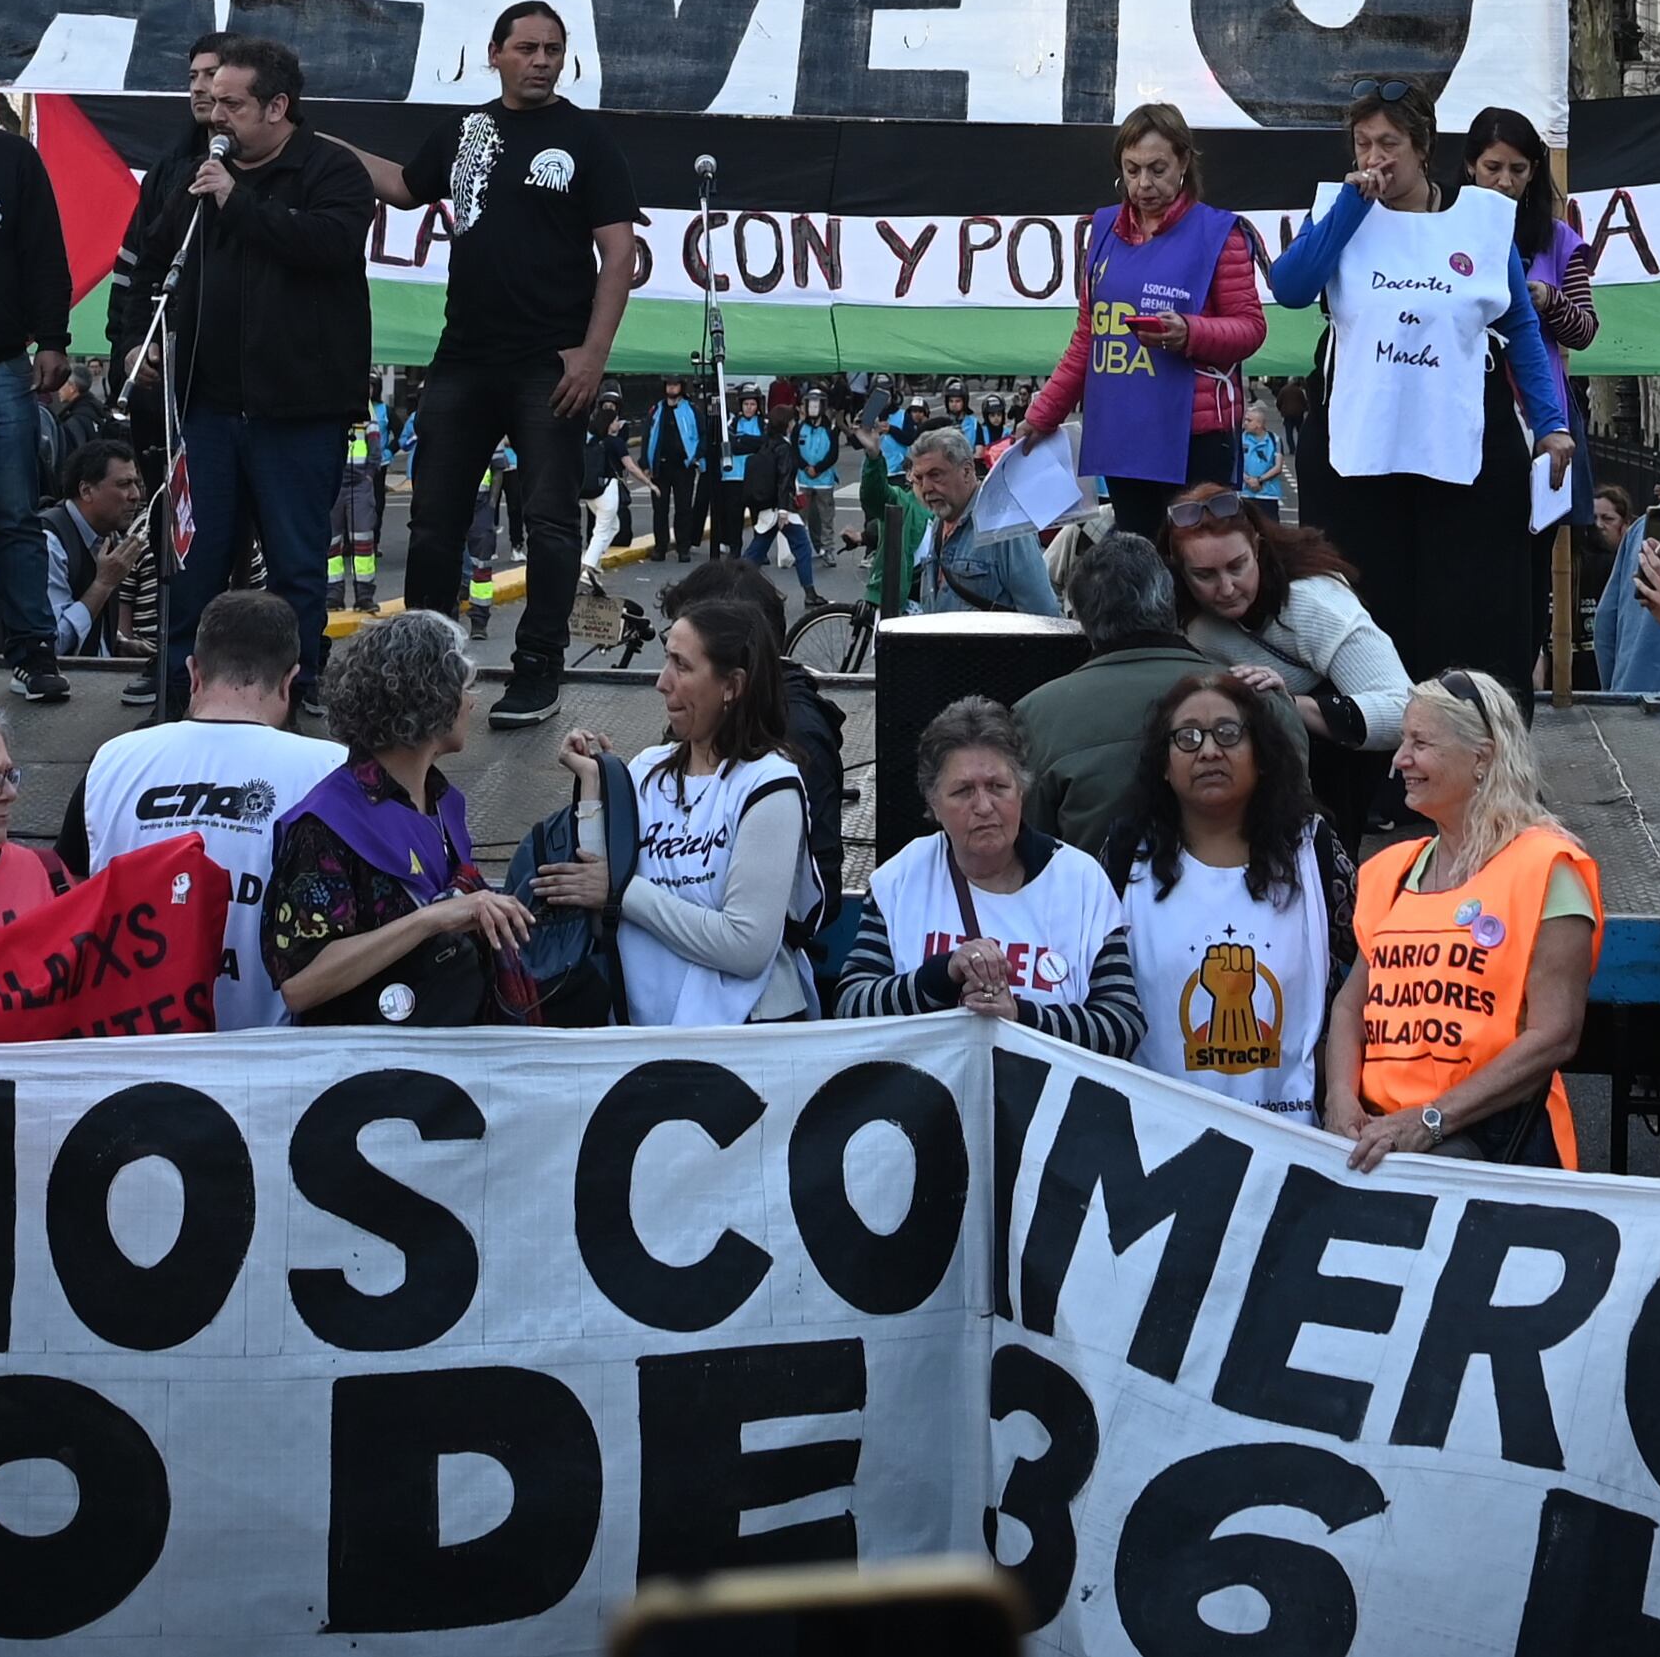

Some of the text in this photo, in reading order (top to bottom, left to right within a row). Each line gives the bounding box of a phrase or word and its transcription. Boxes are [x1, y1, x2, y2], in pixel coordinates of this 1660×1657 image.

[682, 211, 842, 294] CON
[875, 220, 939, 298] Y
[1142, 283, 1191, 301] ASOCIACIÓN
[1372, 270, 1453, 294] Docentes
[1091, 300, 1137, 336] GD
[1141, 297, 1176, 313] GREMIAL
[1398, 310, 1421, 325] en
[1092, 339, 1156, 377] UBA
[1376, 339, 1440, 368] Marcha
[1371, 942, 1489, 975] NARIO DE
[1365, 979, 1496, 1017] AJADORES
[317, 1339, 868, 1635] DE
